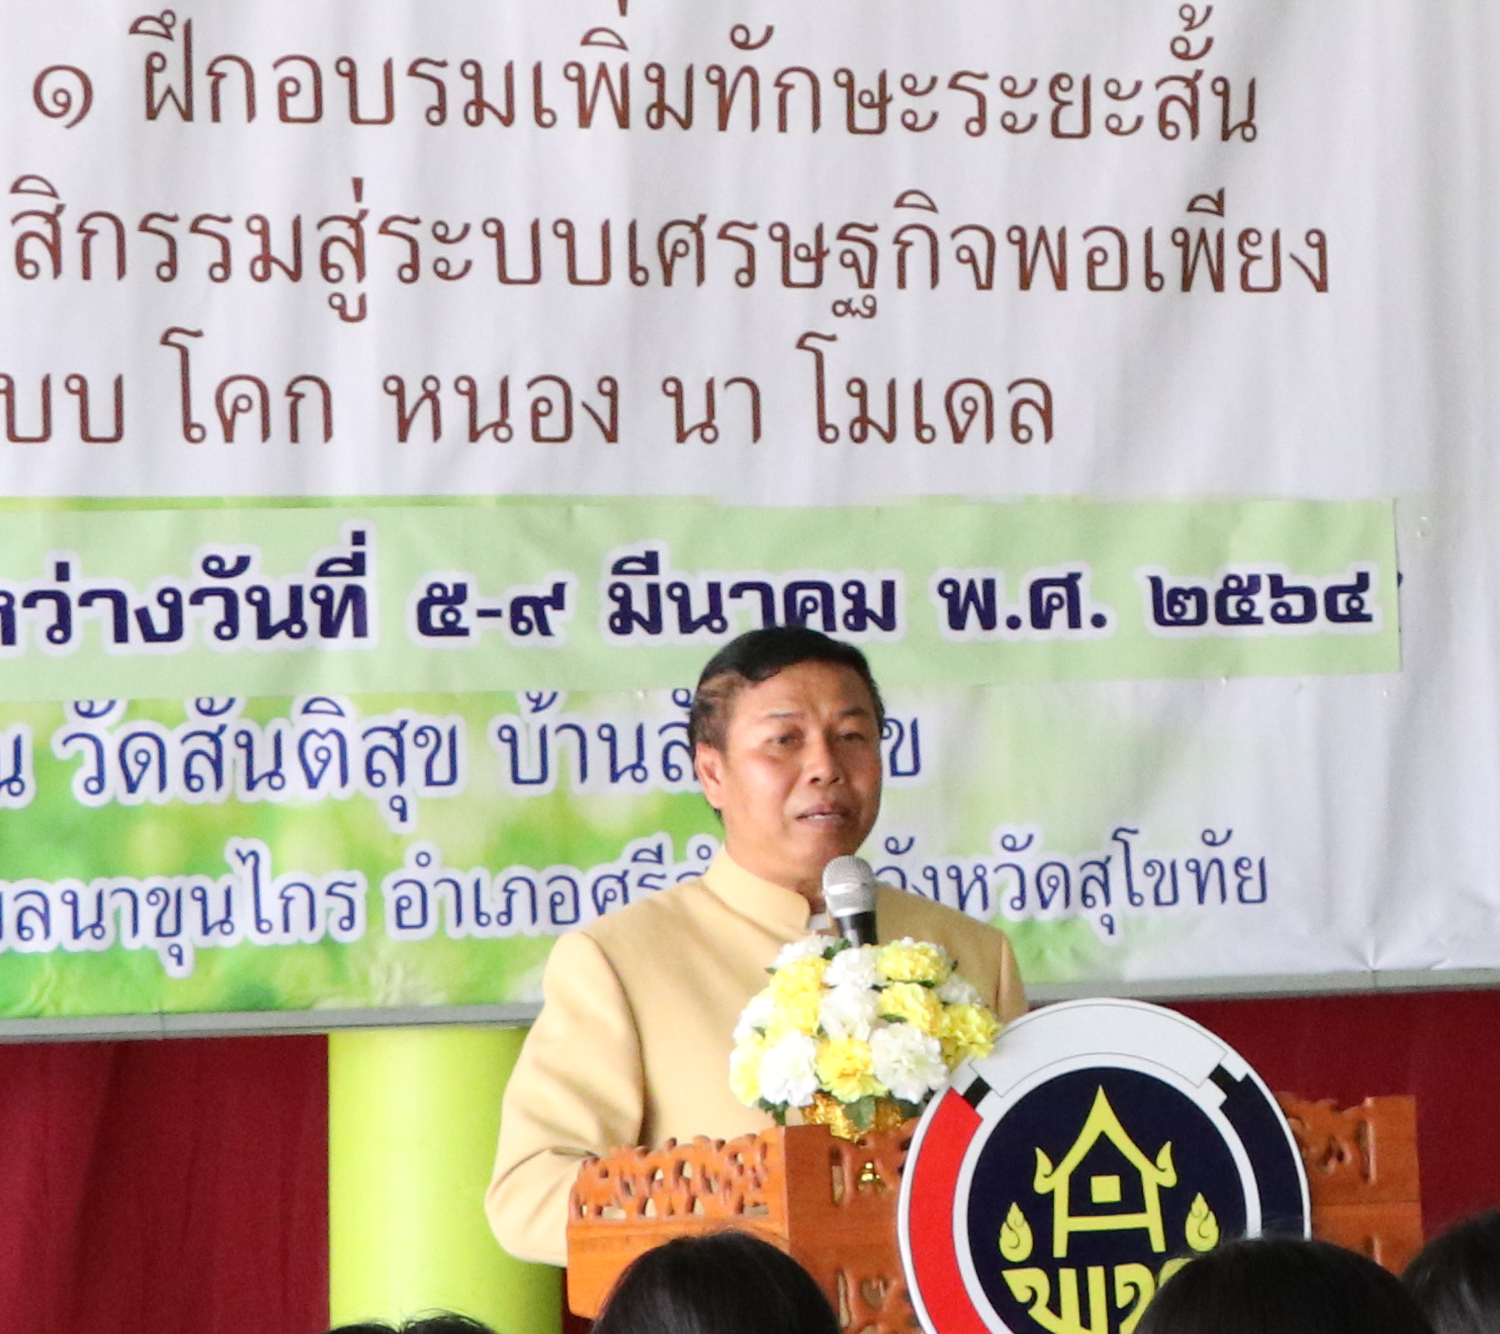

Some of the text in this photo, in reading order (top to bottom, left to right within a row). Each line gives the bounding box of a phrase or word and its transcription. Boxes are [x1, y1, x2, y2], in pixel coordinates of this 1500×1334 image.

[32, 64, 94, 129] ๑
[159, 326, 333, 445] โคก
[382, 373, 619, 445] หนอง
[661, 376, 763, 445] นา
[796, 332, 1055, 445] โมเดล
[416, 581, 566, 637] ๕-๙
[607, 550, 897, 636] มีนาคม
[937, 572, 1108, 631] พ.ศ.
[1149, 571, 1373, 627] ๒๕๖๔
[62, 696, 459, 823] วัดสันติสุข
